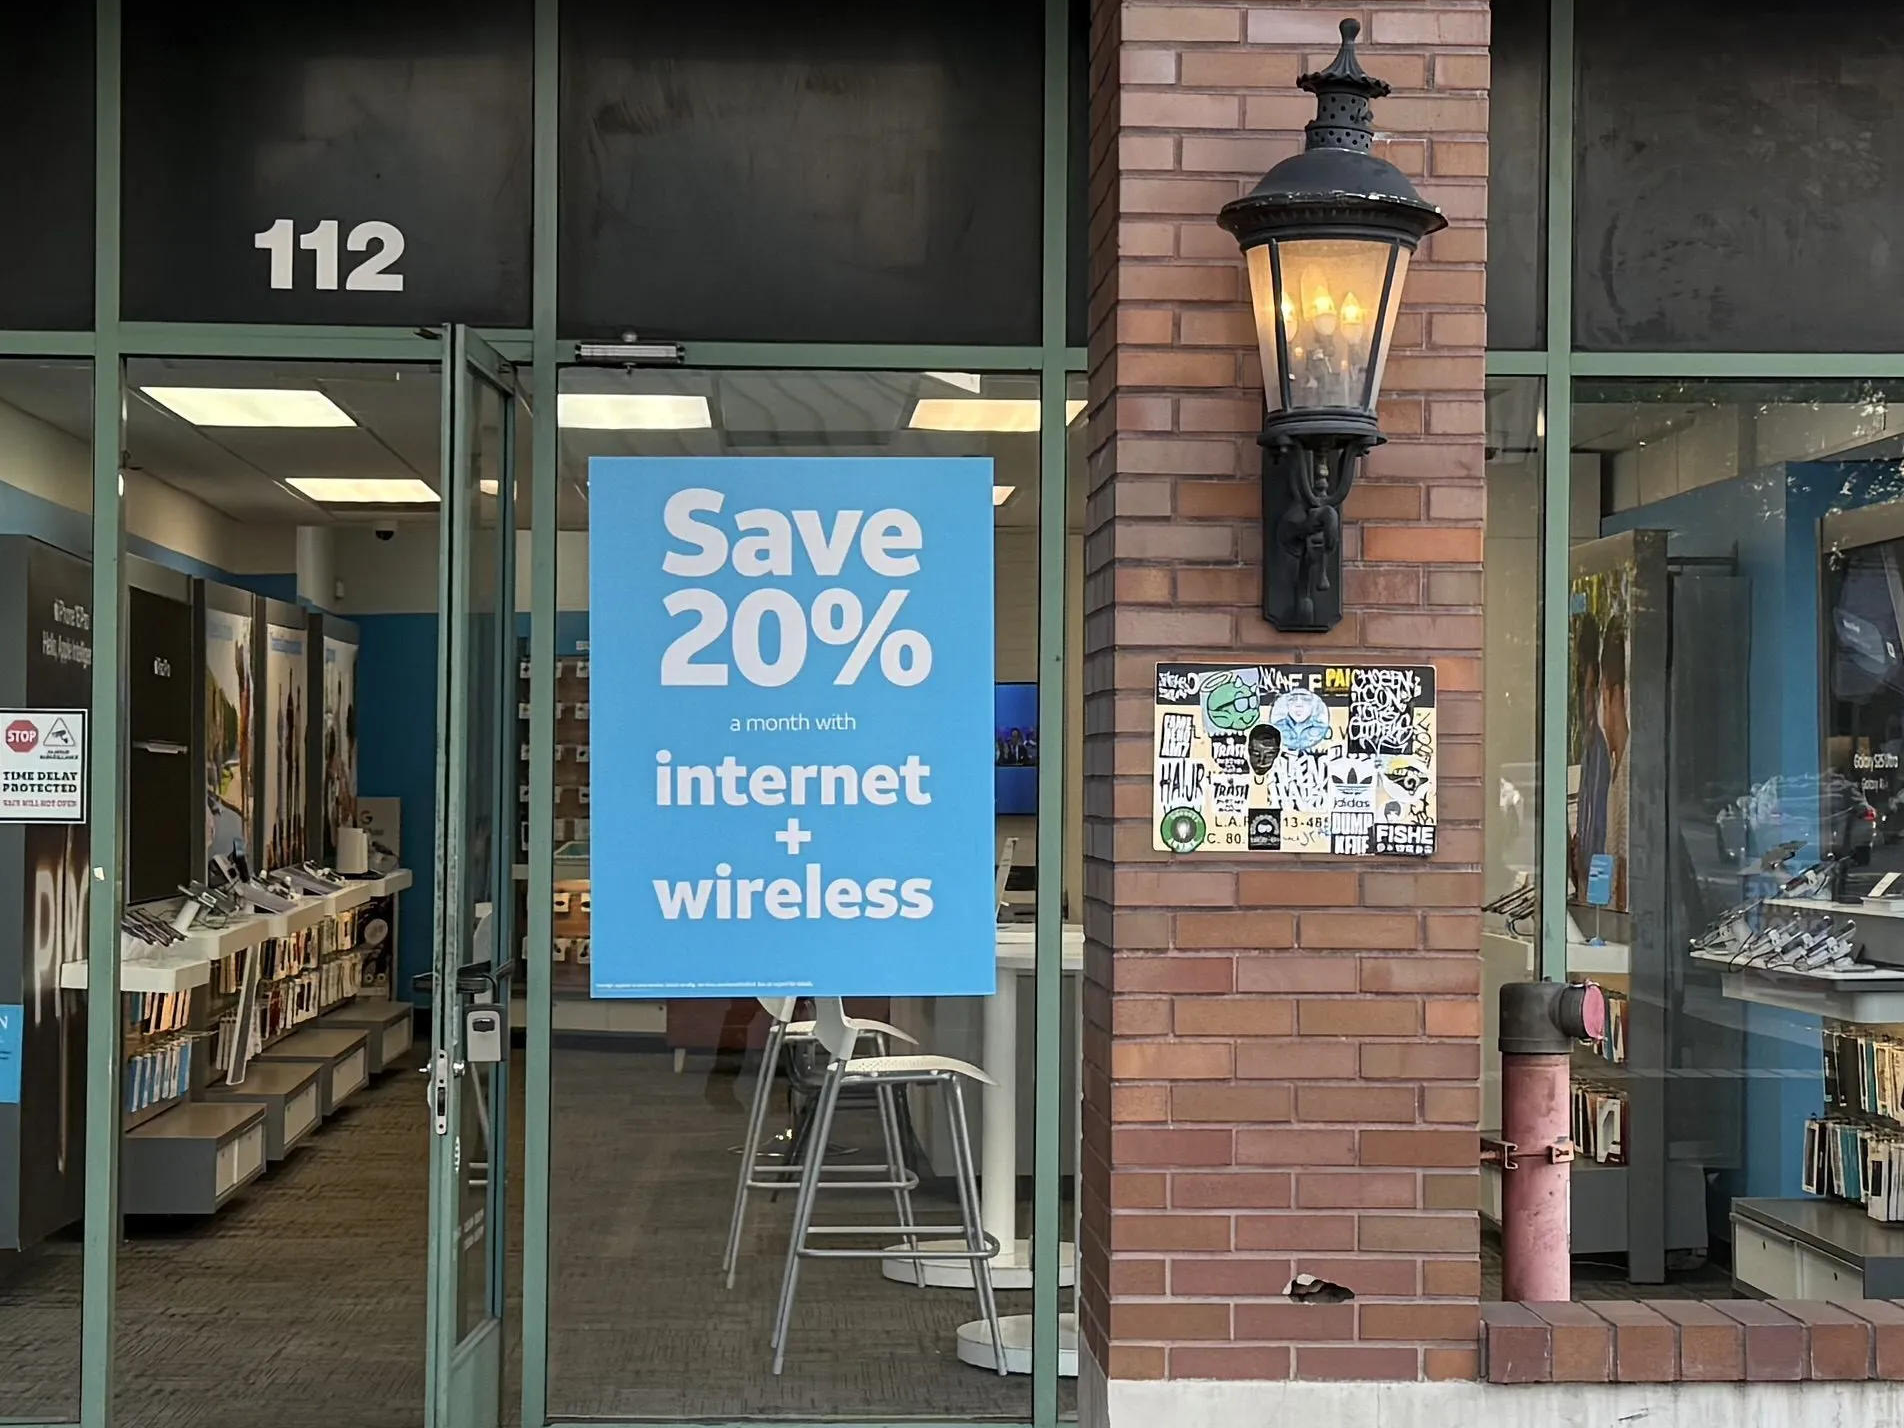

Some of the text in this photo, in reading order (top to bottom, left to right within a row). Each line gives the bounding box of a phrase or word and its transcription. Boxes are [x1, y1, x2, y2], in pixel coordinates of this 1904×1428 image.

[255, 219, 405, 291] 112
[662, 488, 923, 577] Save
[661, 587, 932, 687] 20%
[7, 729, 37, 744] STOP
[729, 712, 856, 732] a month with
[3, 771, 78, 781] TIME DELAY
[3, 783, 77, 793] PROTECTED
[656, 750, 932, 806] internet
[1214, 782, 1249, 799] TRASH
[775, 818, 812, 855] +
[654, 863, 933, 919] wireless
